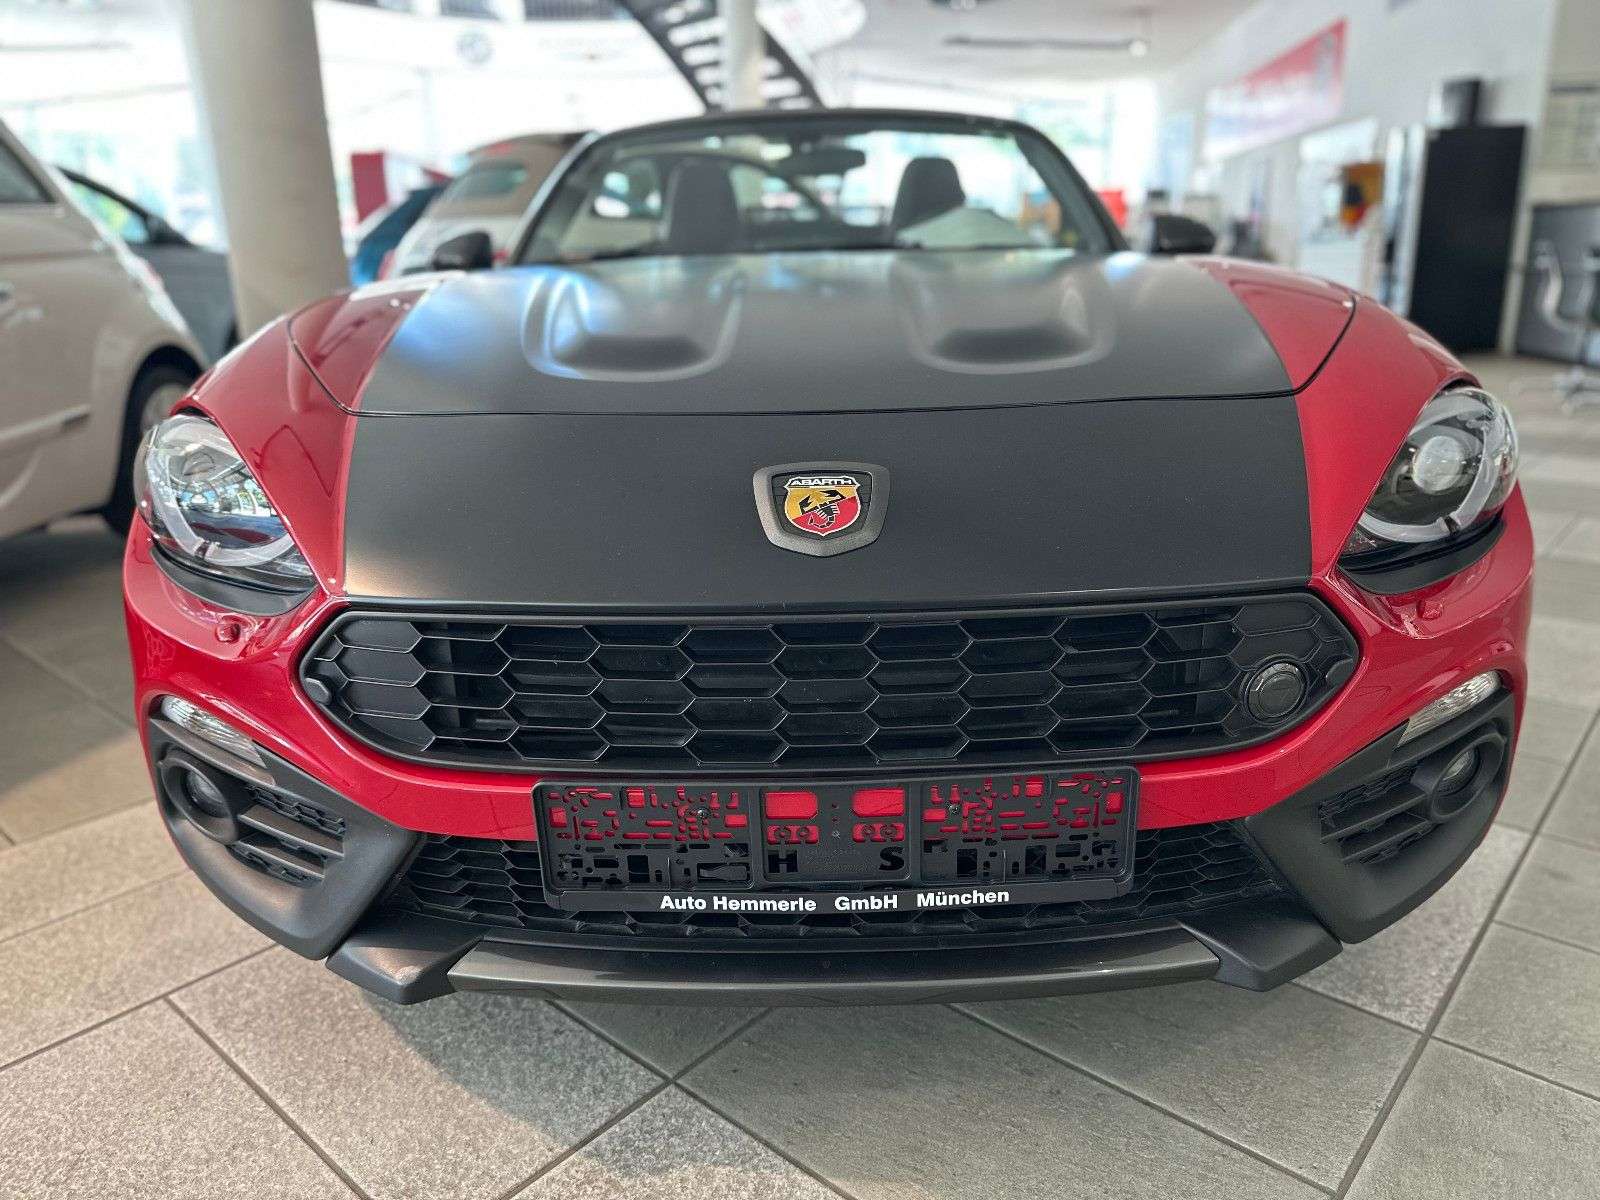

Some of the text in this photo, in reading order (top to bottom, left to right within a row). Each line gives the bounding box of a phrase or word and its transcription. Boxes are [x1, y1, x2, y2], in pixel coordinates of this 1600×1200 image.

[790, 478, 852, 486] ABARTH
[660, 890, 1009, 911] Auto Hemmerle GmbH München
